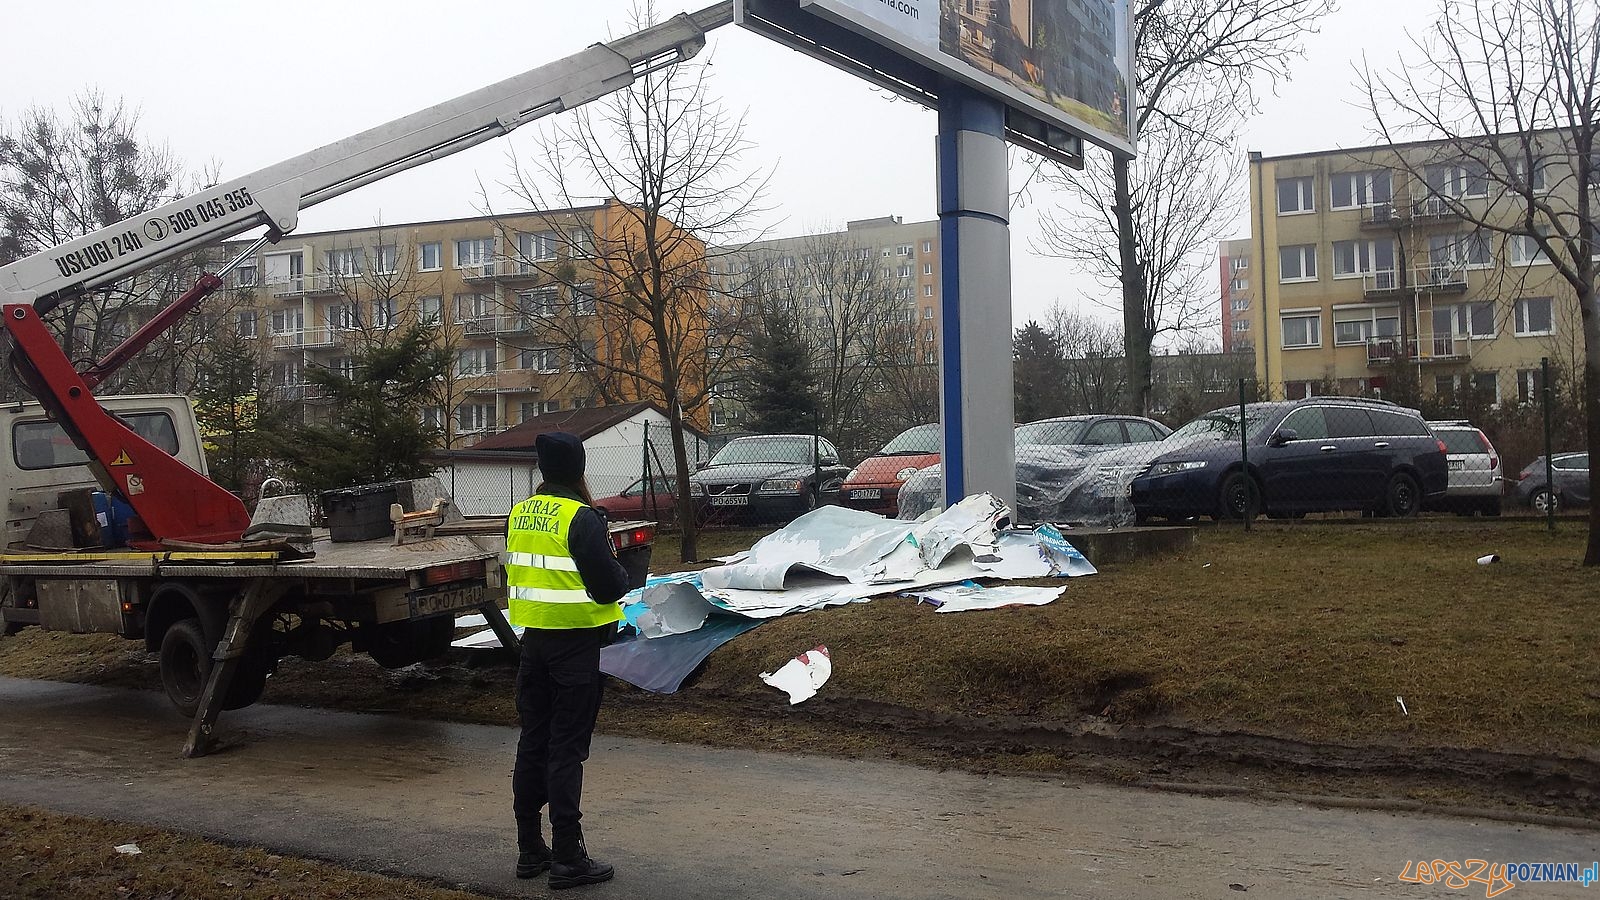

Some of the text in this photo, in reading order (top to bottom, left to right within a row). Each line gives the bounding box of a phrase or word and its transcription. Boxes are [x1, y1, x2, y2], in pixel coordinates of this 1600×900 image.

[55, 187, 255, 277] USŁUGI 24h 509 045 355
[513, 515, 560, 535] MIEJSKA
